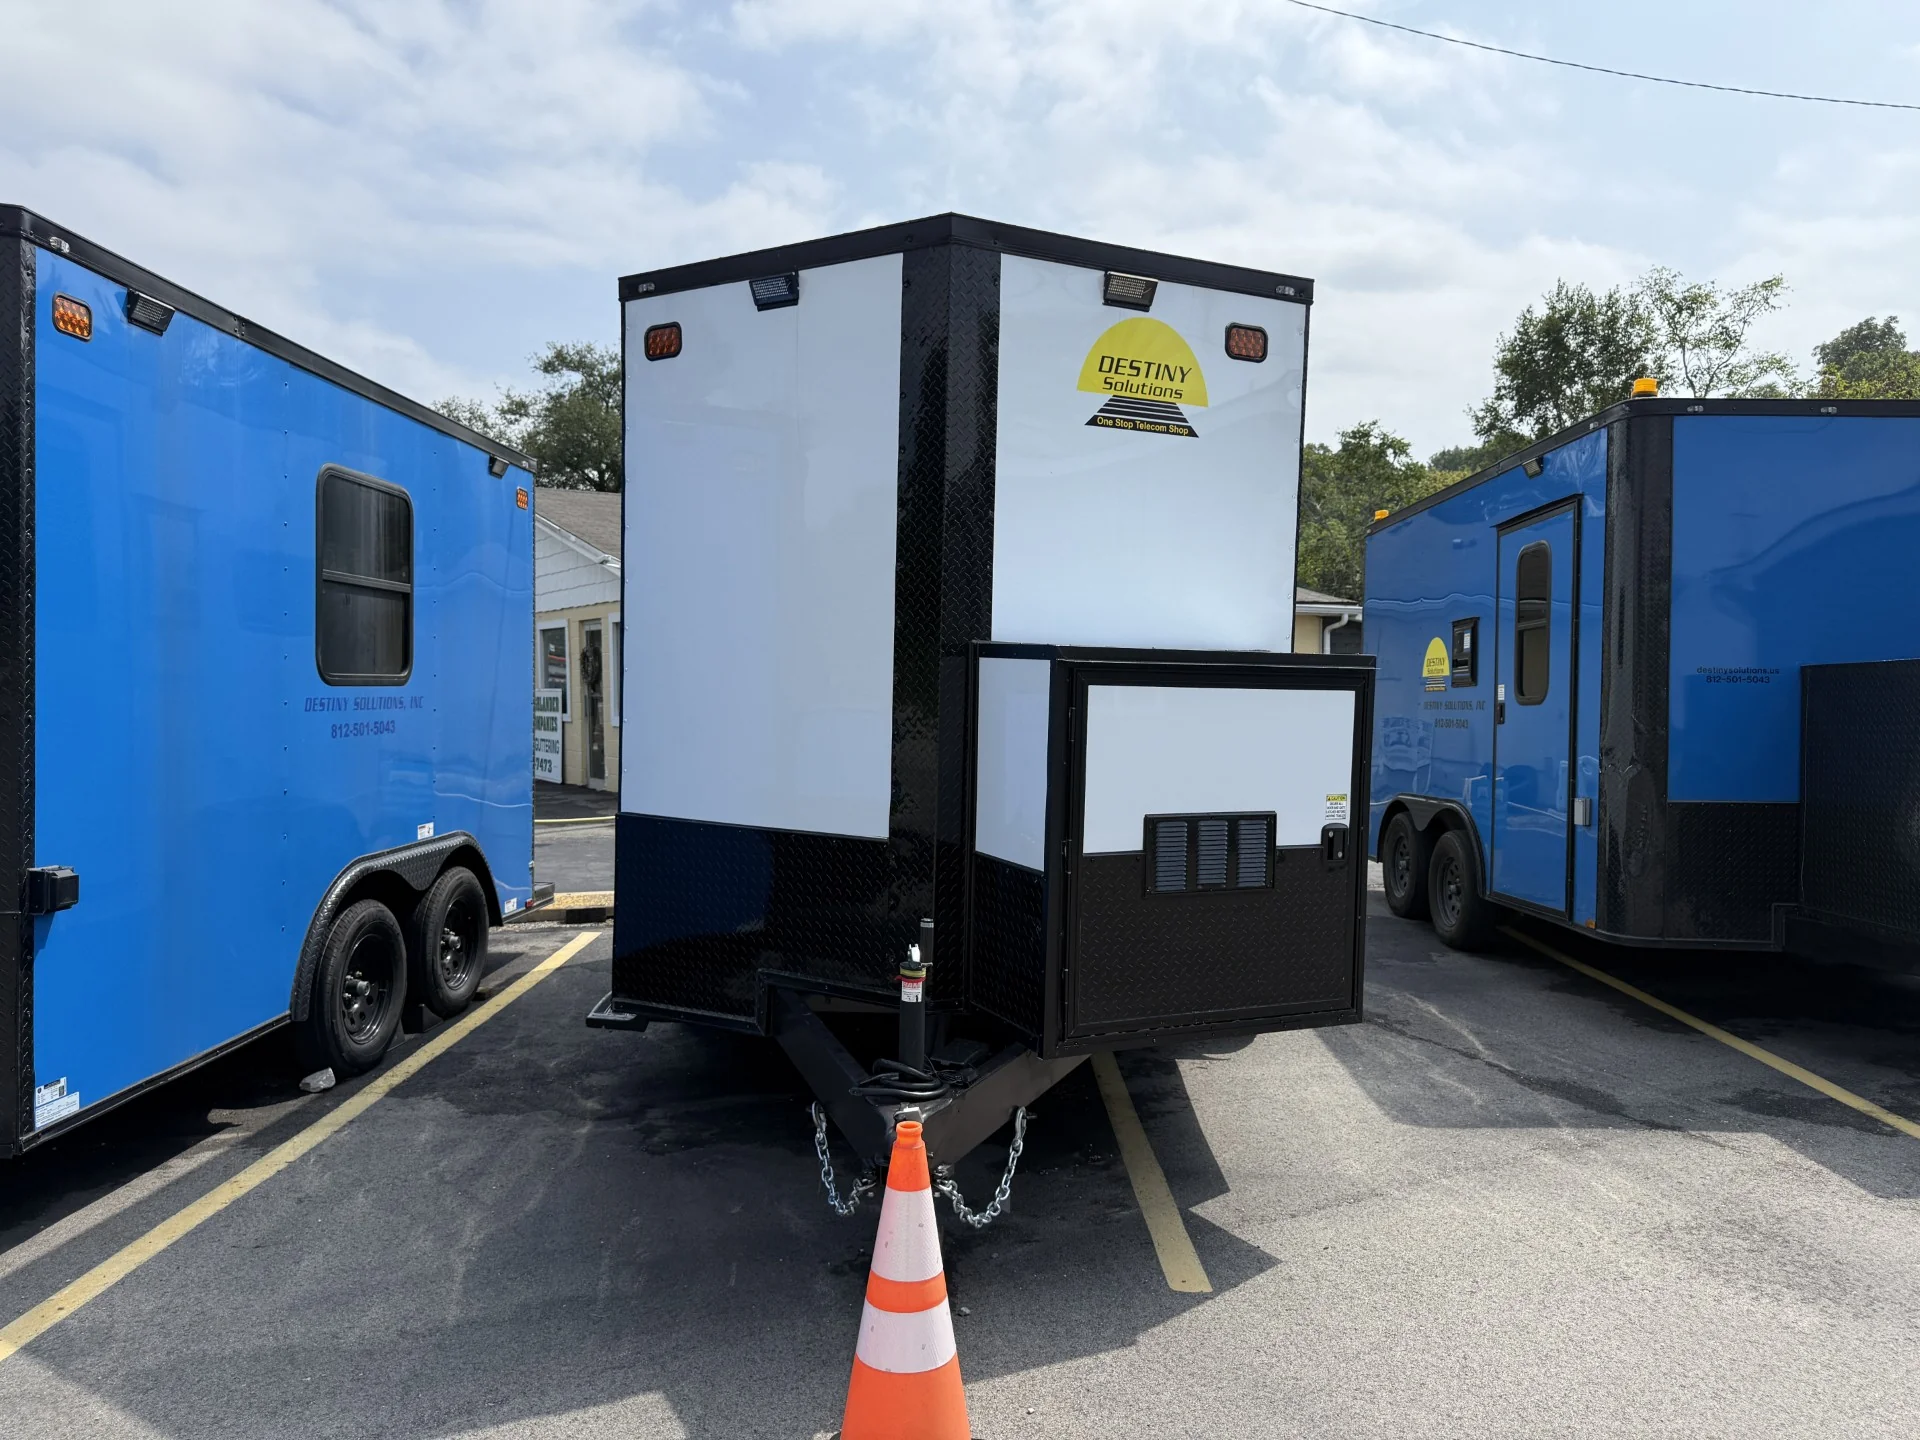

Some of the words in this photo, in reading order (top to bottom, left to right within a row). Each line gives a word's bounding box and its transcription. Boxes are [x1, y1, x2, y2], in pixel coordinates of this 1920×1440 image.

[1098, 355, 1192, 383] DESTINY
[1102, 376, 1184, 399] Solutions
[1097, 416, 1113, 426] One
[1115, 418, 1134, 429] Stop
[1135, 420, 1167, 432] Telecom
[1168, 424, 1189, 436] Shop
[1426, 657, 1445, 667] DESTINY
[1696, 665, 1780, 675] destinysolutions.us
[1706, 675, 1771, 684] 812-501-5043
[304, 697, 349, 712] DESTINY
[331, 720, 396, 739] 812-501-5043
